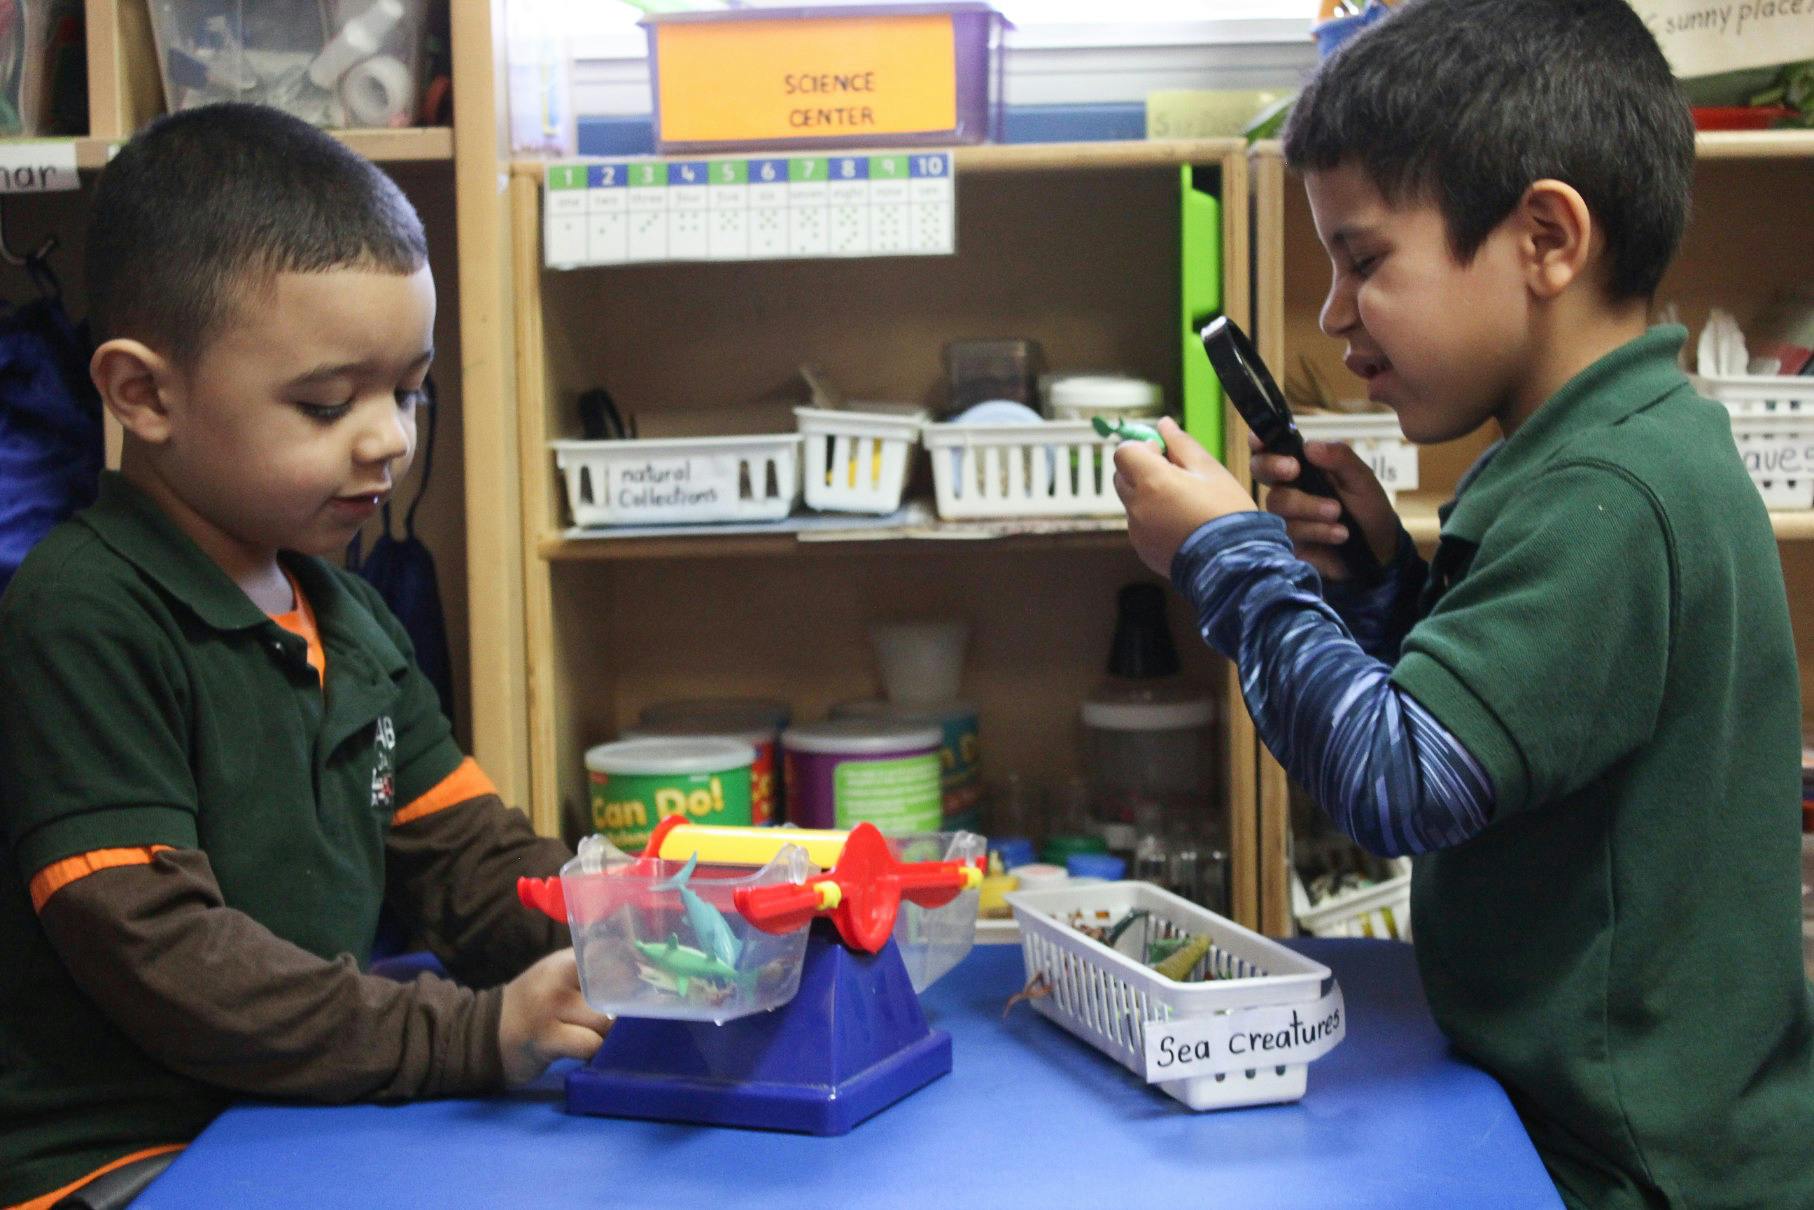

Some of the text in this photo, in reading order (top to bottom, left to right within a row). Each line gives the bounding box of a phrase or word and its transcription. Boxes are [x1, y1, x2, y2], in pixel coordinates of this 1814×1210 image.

[1665, 4, 1733, 34] sunny
[784, 71, 876, 95] SCIENCE
[788, 106, 876, 128] CENTER
[564, 156, 945, 186] 1 2 3 4 5 6 7 8 9 10
[621, 460, 691, 483] natural
[591, 796, 647, 830] Can
[655, 776, 725, 822] Do!
[1157, 1035, 1211, 1068] Sea
